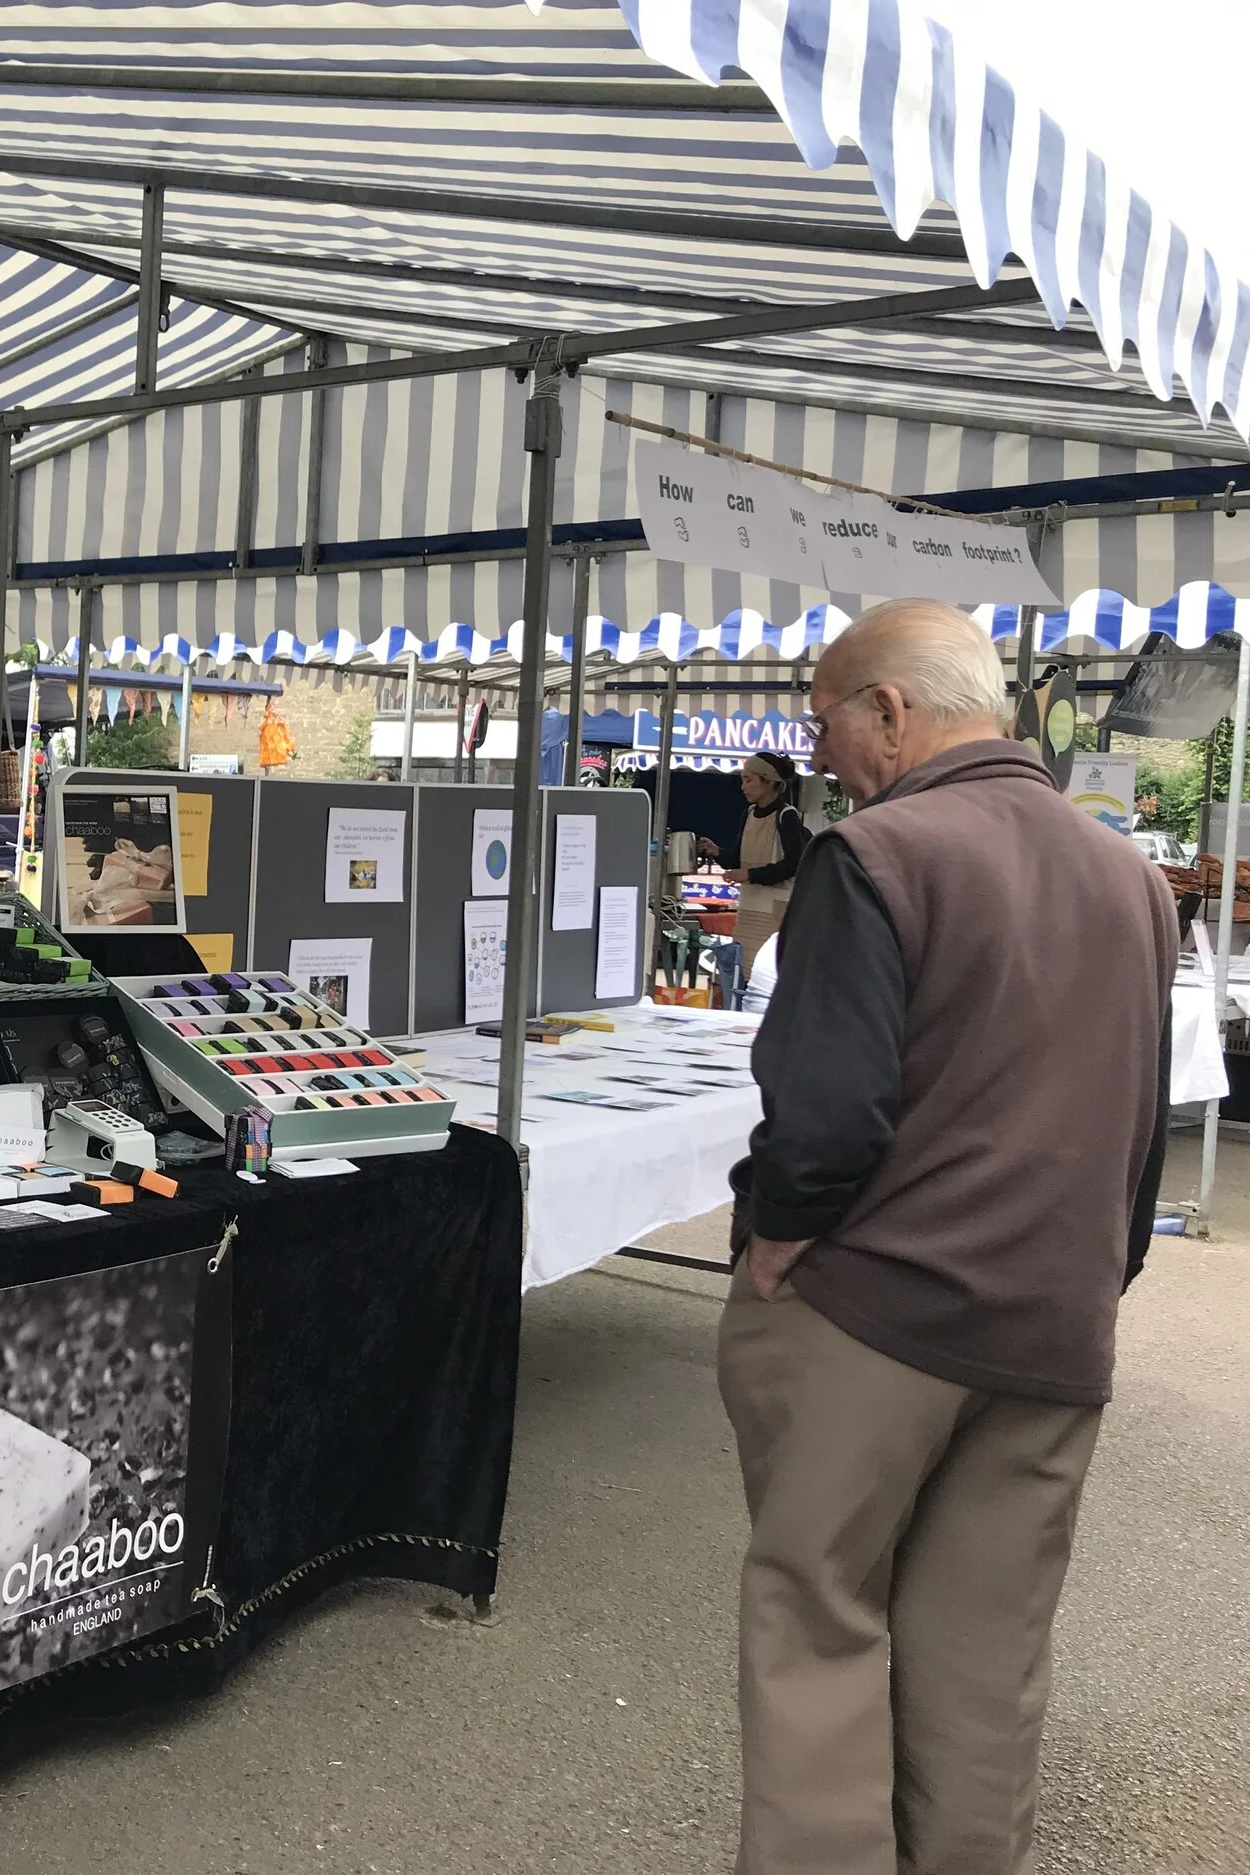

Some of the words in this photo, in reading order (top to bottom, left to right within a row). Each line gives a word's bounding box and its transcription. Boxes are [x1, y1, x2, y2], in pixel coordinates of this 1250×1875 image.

[658, 475, 693, 504] How
[726, 492, 754, 514] can
[789, 507, 806, 528] we
[822, 519, 878, 539] reduce
[912, 537, 952, 558] carbon
[688, 716, 815, 752] PANCAKE
[65, 825, 112, 835] chaaboo
[1, 1512, 184, 1605] chaaboo
[30, 1599, 101, 1632] handmade
[104, 1590, 126, 1607] tea
[129, 1578, 162, 1598] soap
[73, 1607, 122, 1636] ENGLAND
